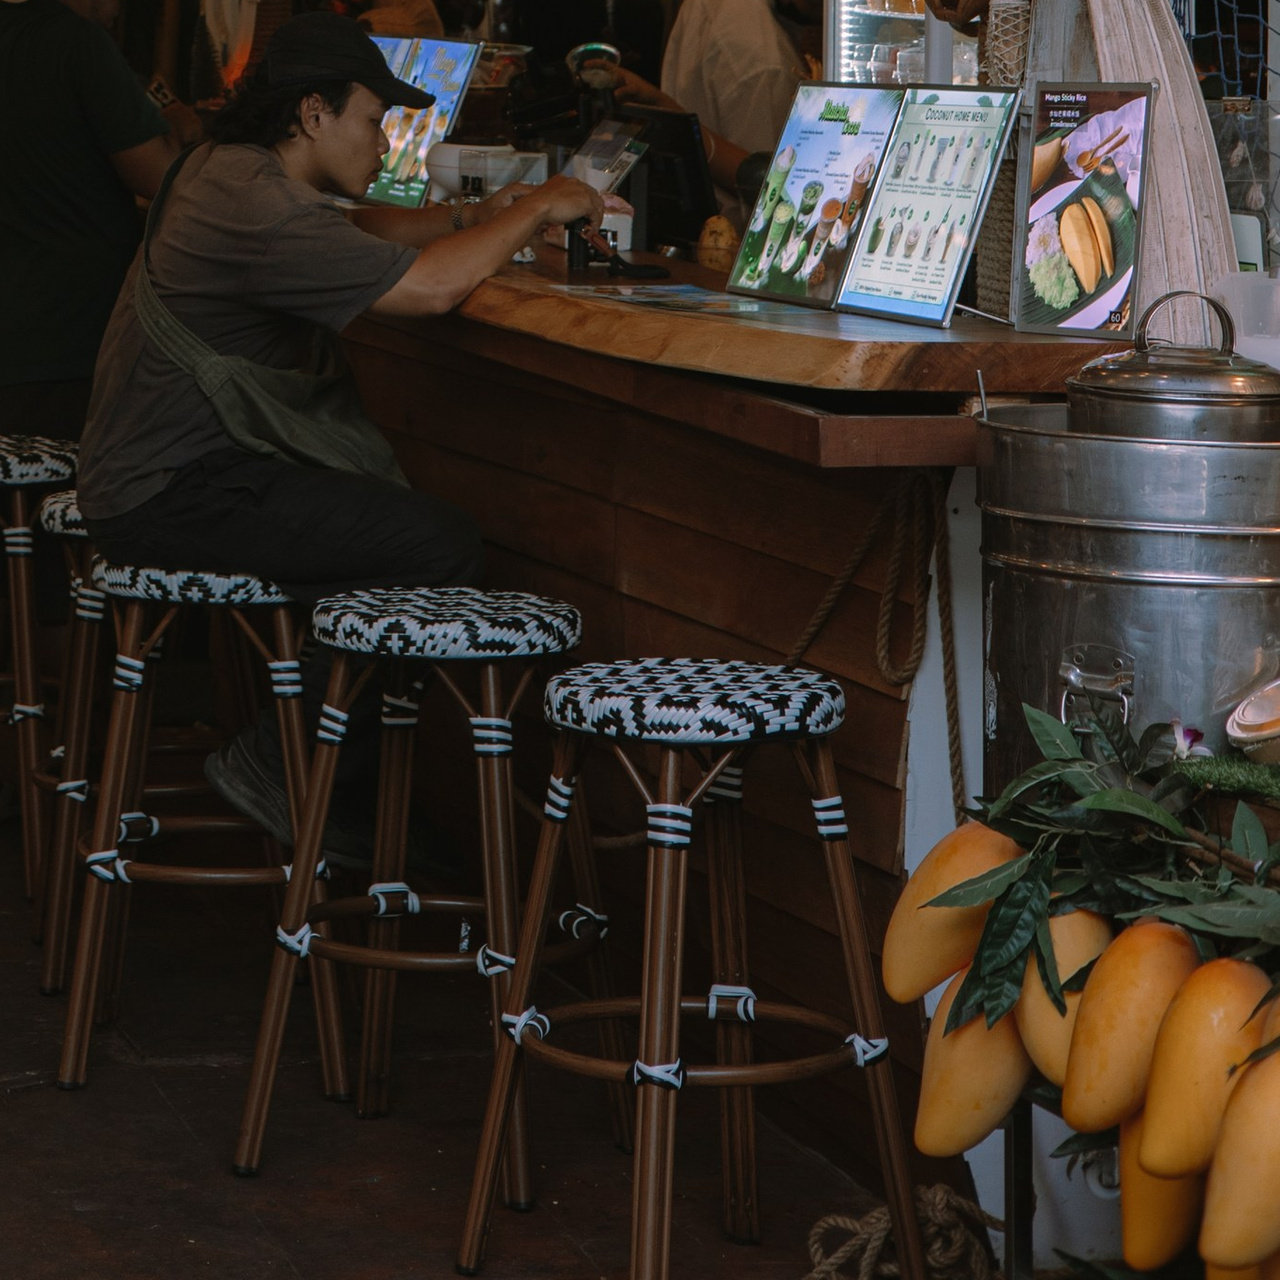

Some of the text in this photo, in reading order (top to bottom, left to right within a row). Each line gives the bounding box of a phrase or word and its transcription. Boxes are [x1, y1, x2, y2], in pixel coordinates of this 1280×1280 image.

[1045, 93, 1087, 103] Mango Sticky Rice
[1110, 312, 1121, 323] 60
